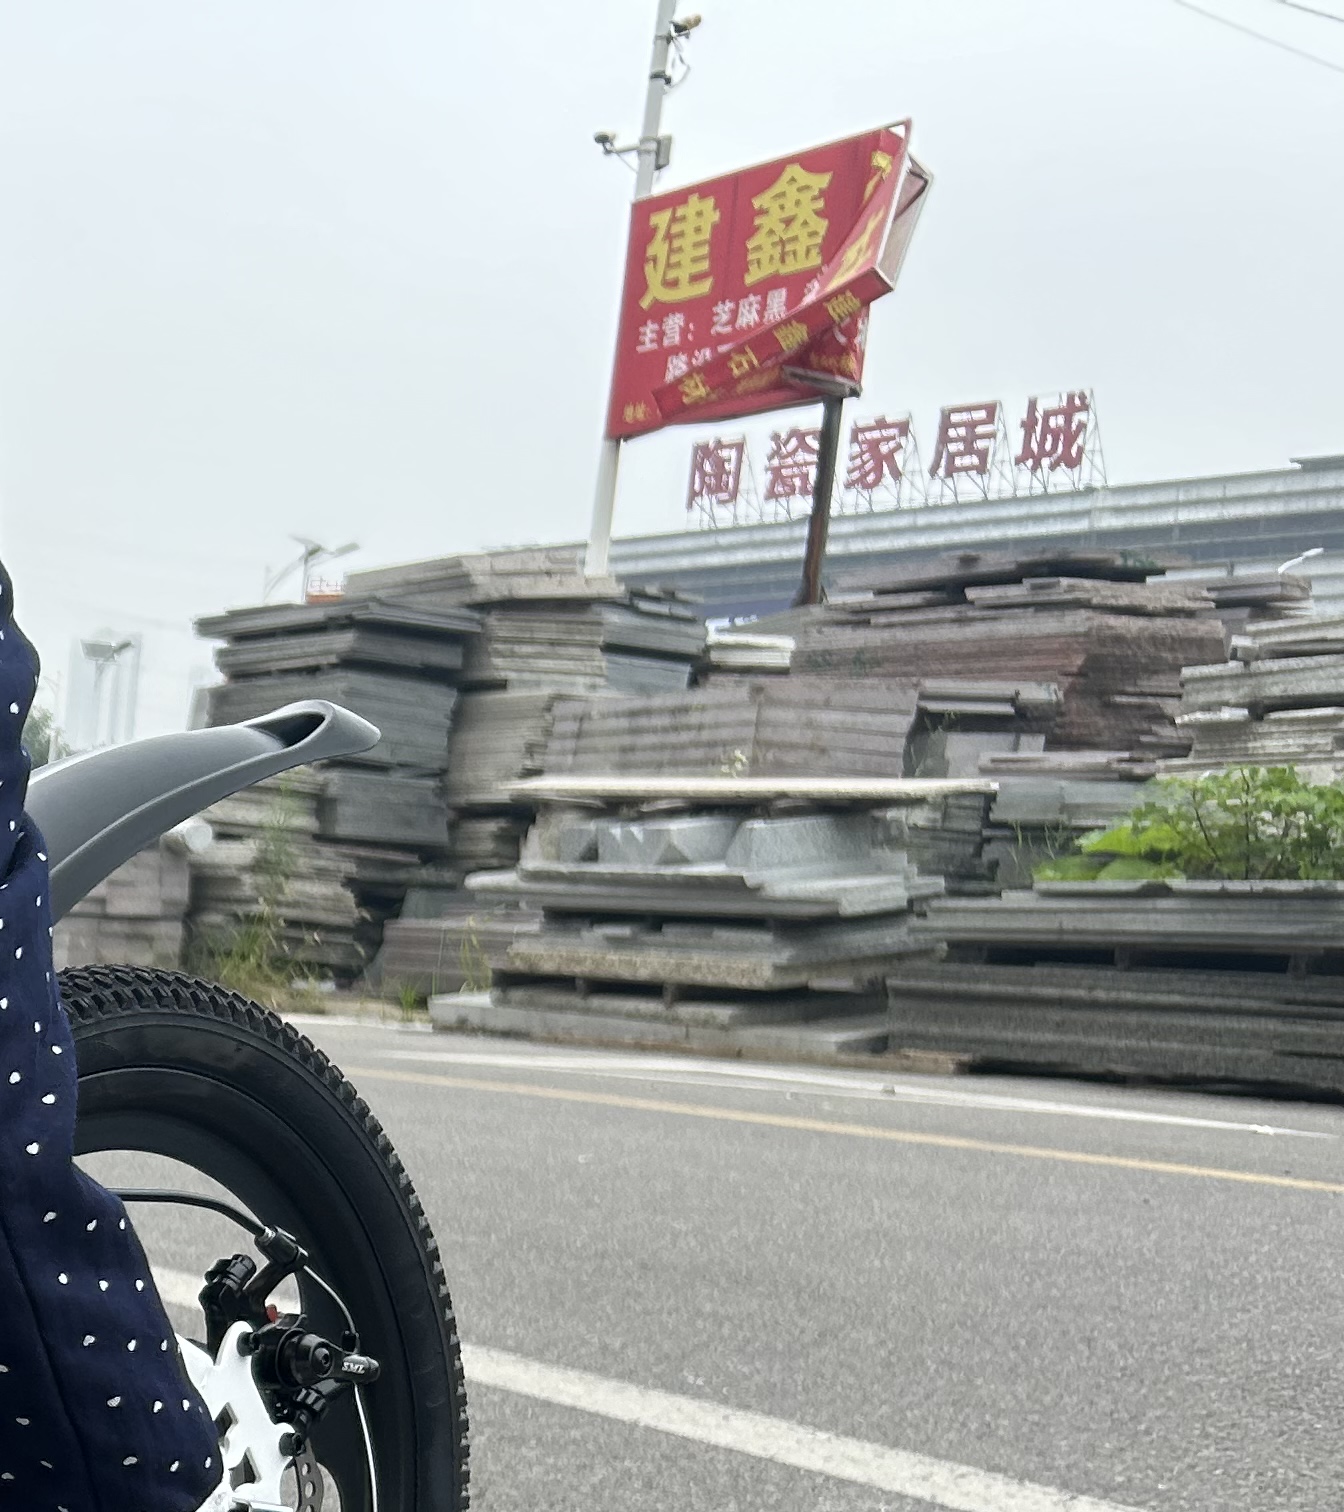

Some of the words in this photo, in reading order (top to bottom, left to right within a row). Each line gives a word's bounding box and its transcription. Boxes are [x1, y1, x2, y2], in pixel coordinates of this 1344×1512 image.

[686, 390, 1091, 510] 陶瓷家居城
